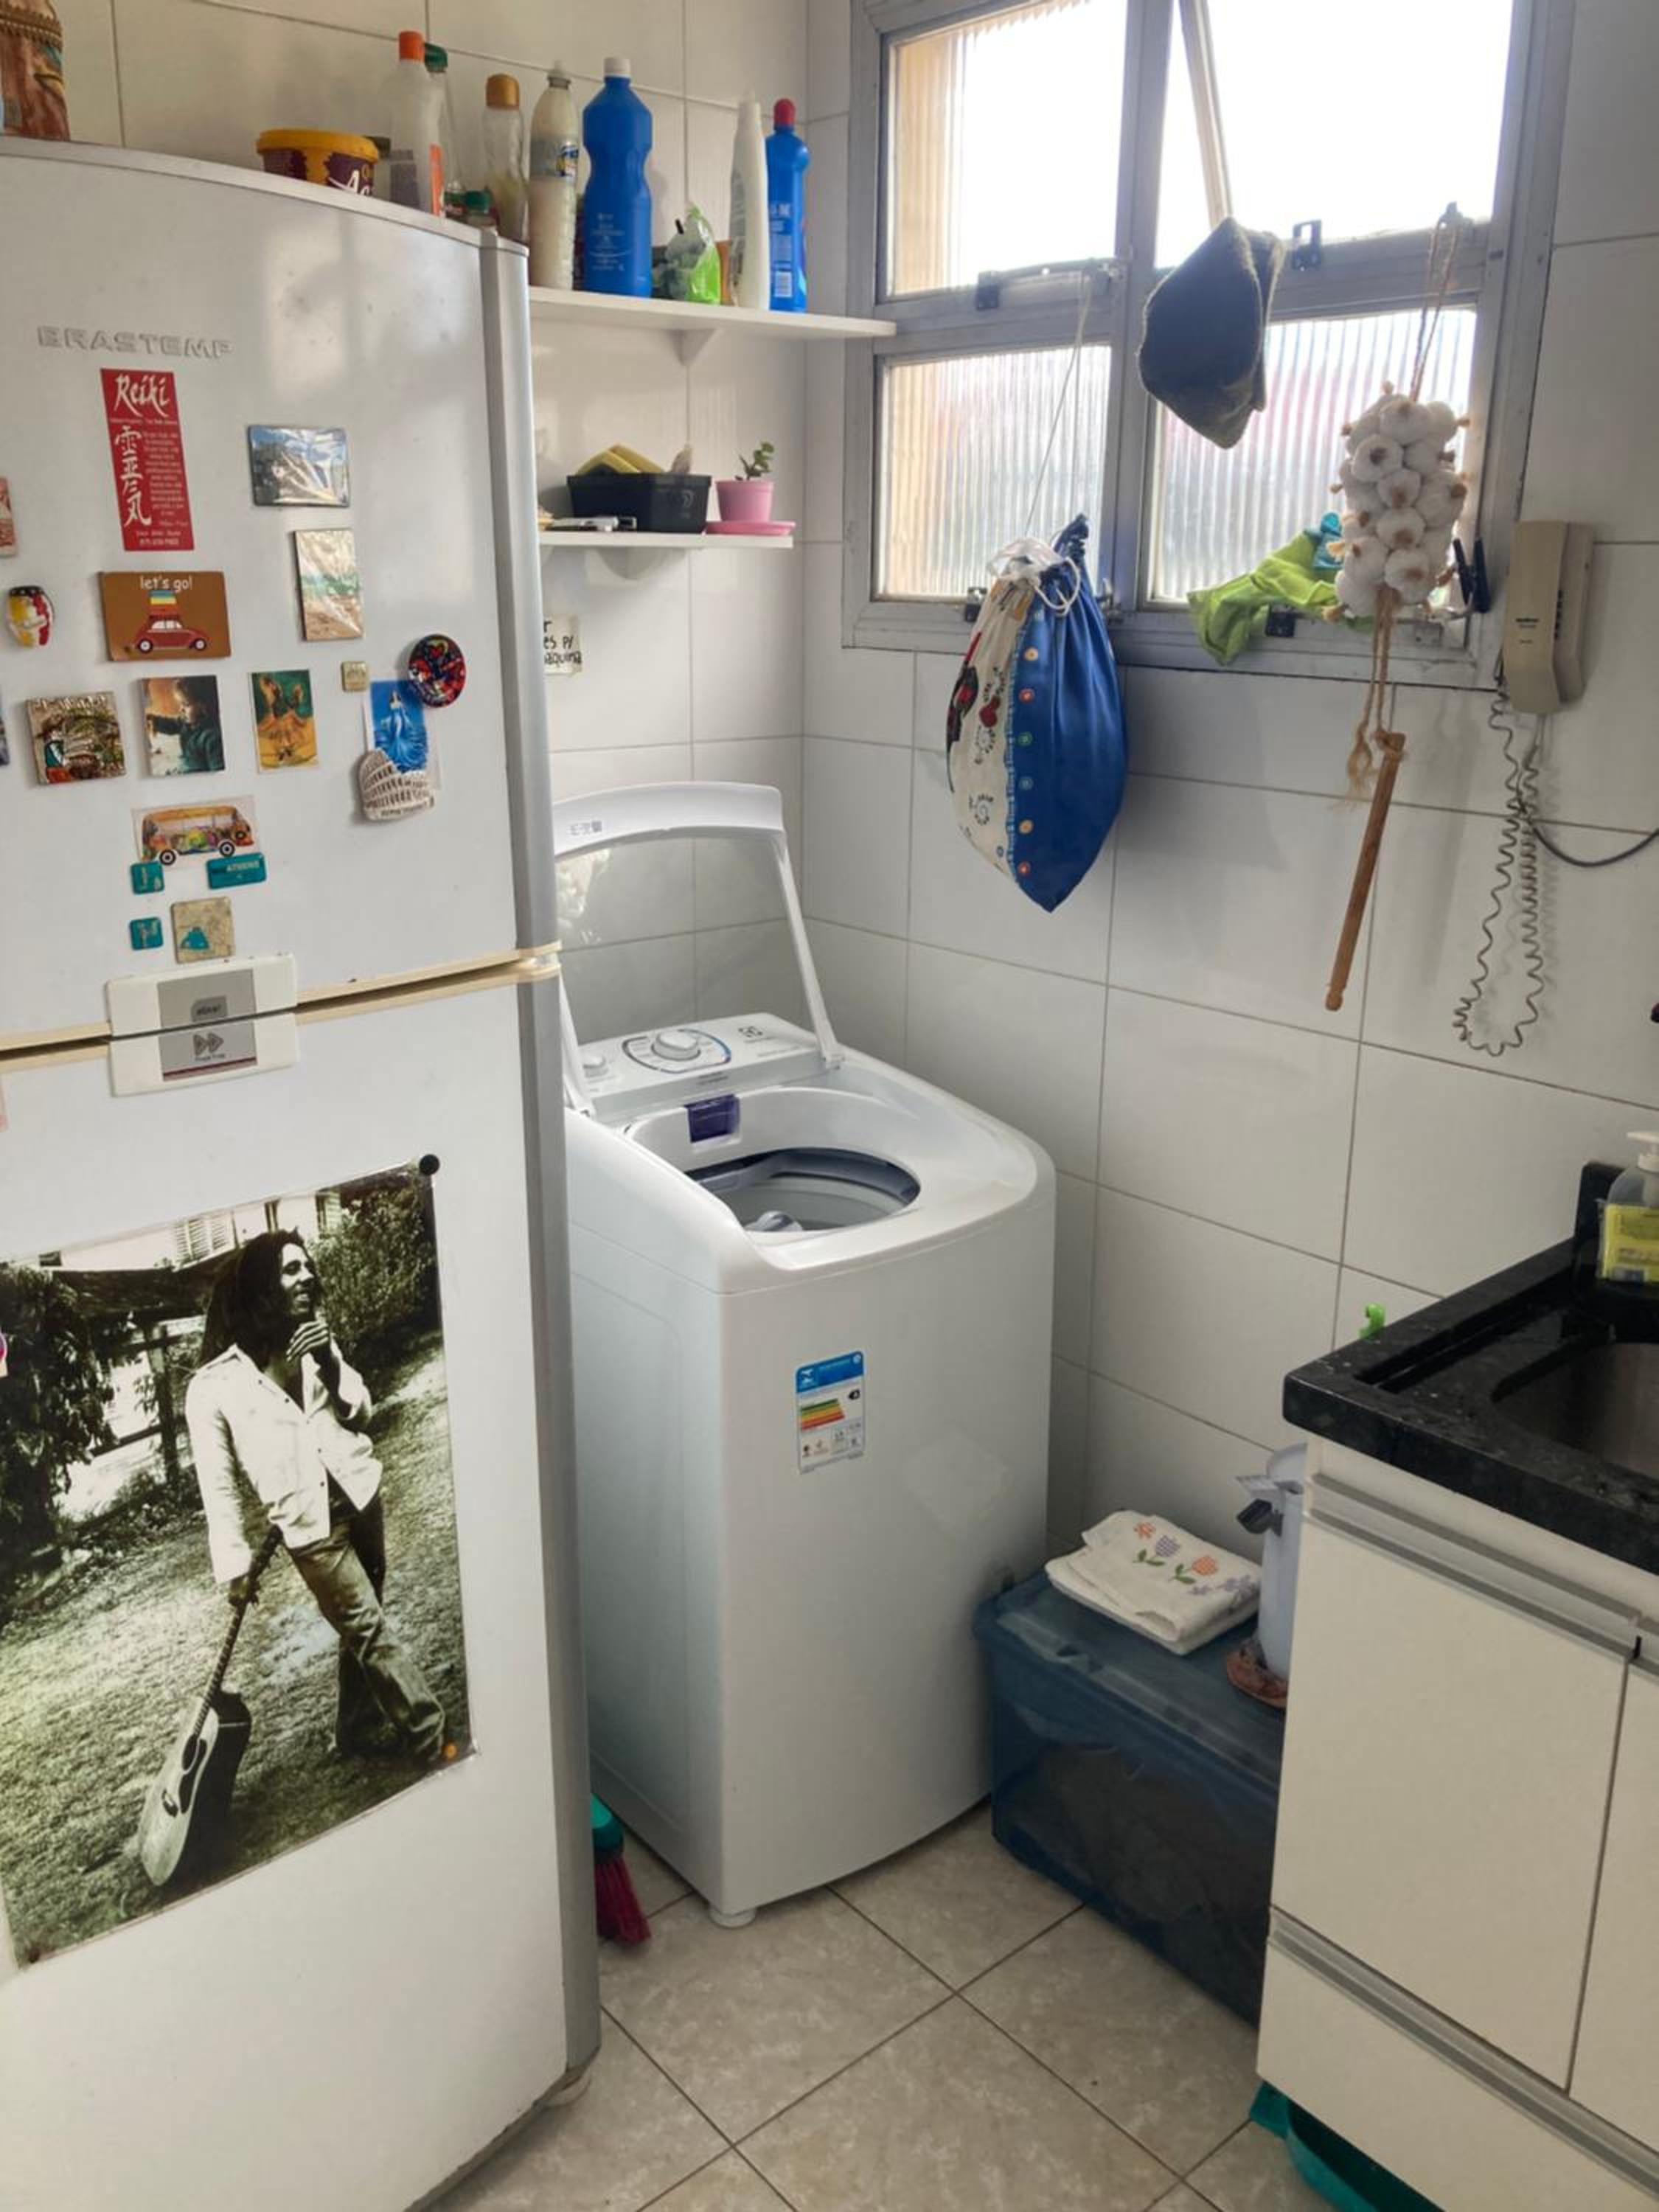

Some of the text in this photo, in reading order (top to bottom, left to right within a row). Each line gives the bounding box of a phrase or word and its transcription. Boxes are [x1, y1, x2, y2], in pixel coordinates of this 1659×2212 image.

[36, 324, 233, 358] BRASTEMP
[114, 374, 170, 418] Reiki
[140, 575, 193, 594] let's go!
